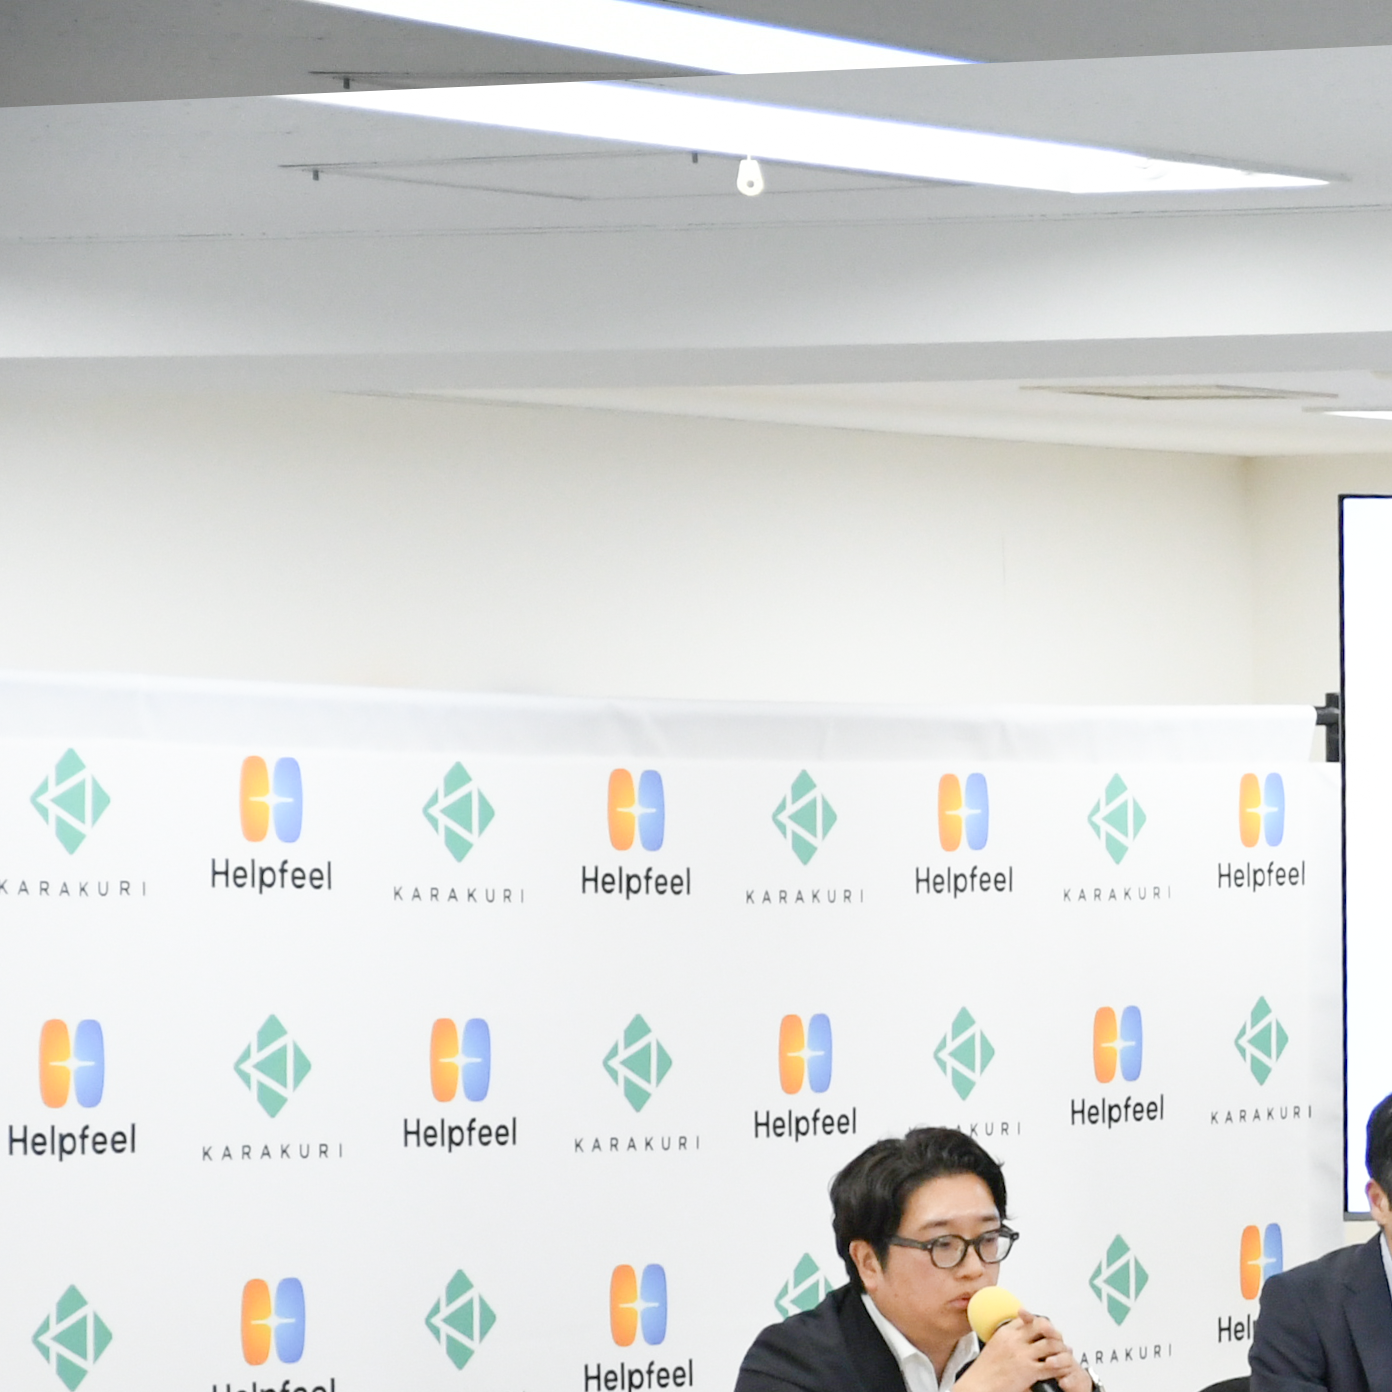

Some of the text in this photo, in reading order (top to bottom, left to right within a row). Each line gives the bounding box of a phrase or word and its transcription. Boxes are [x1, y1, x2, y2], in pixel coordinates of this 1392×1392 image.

[0, 879, 146, 897] KARAKURI
[211, 858, 332, 895] Helpfeel
[581, 865, 691, 901] Helpfeel
[915, 865, 1013, 899] Helpfeel
[1218, 860, 1305, 893] Helpfeel
[393, 887, 524, 903] KARAKURI
[746, 889, 863, 904] KARAKURI
[1063, 885, 1172, 901] KARAKURI
[1071, 1094, 1164, 1129] Helpfeel
[1210, 1105, 1312, 1124] KARAKURI
[403, 1116, 517, 1153] Helpfeel
[754, 1106, 857, 1143] Helpfeel
[955, 1121, 1021, 1139] KURI
[8, 1122, 136, 1162] Helpfeel
[202, 1143, 342, 1161] KARAKURI
[574, 1135, 699, 1152] KARAKURI
[1080, 1343, 1172, 1366] ARAKURI
